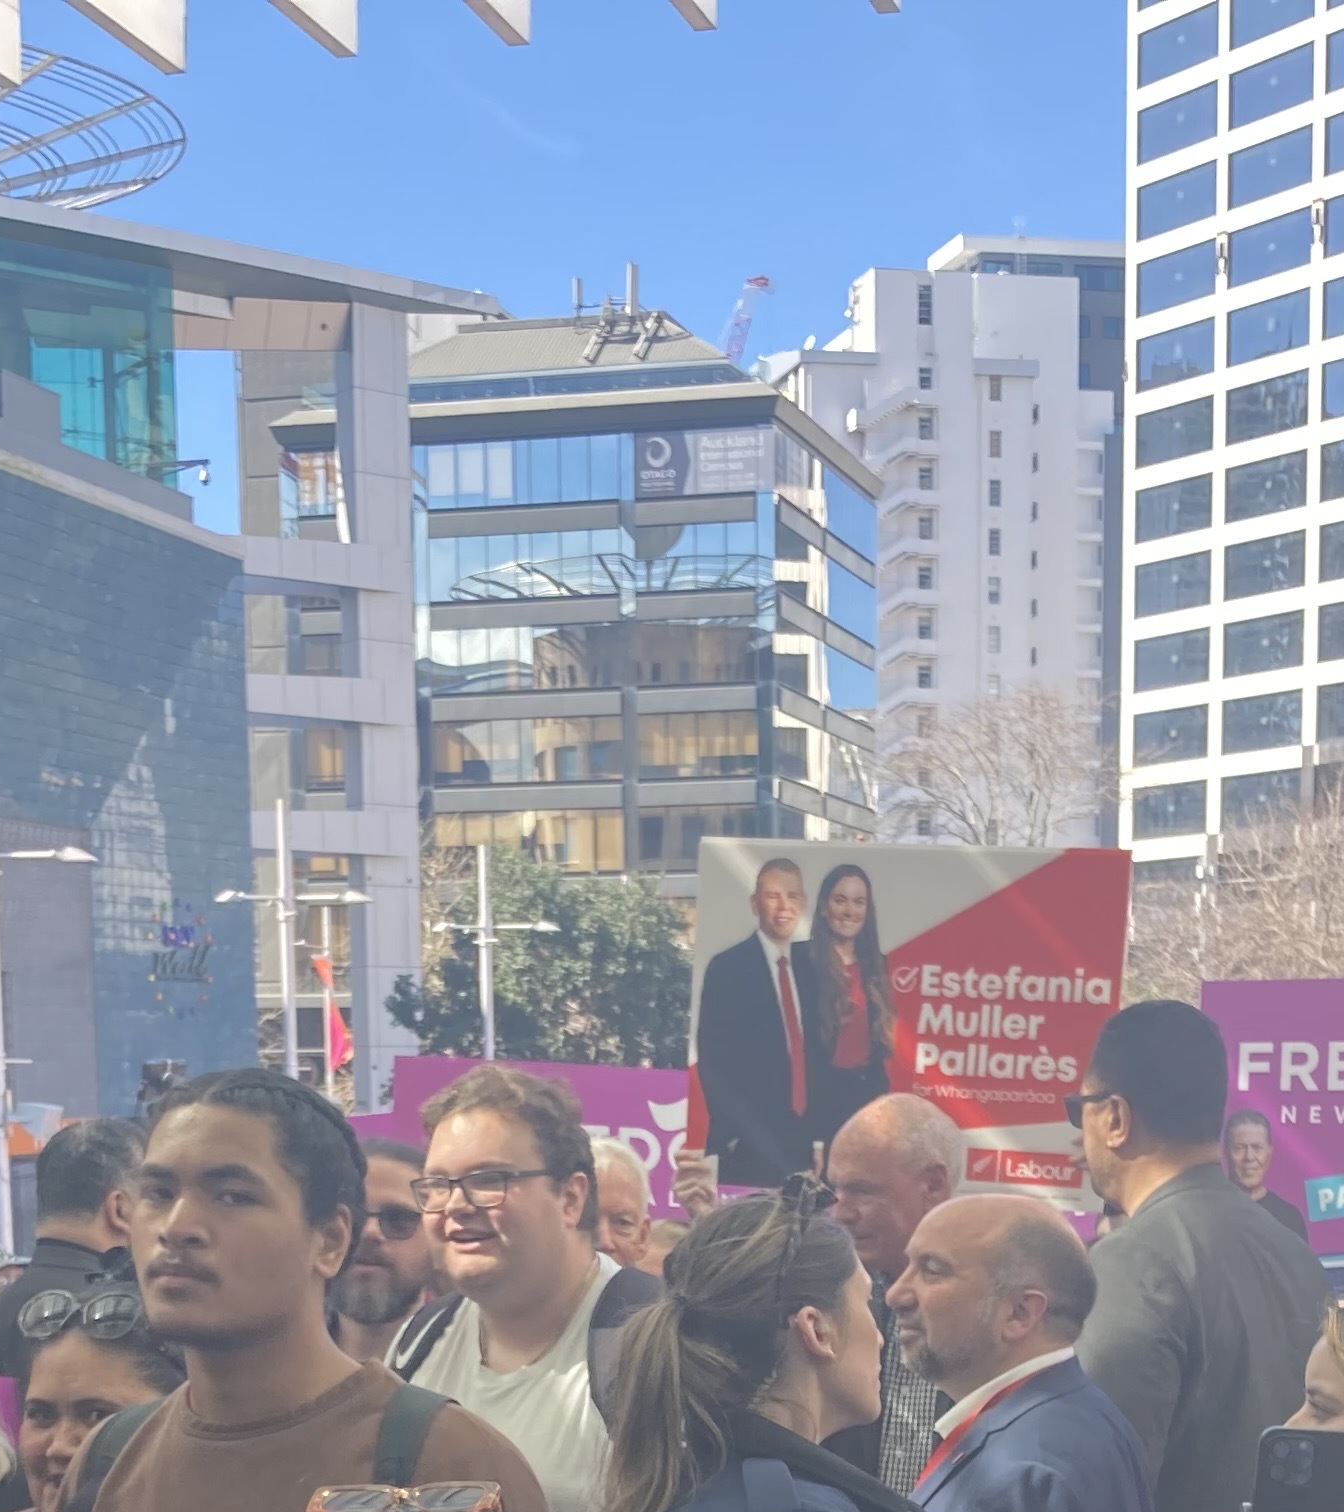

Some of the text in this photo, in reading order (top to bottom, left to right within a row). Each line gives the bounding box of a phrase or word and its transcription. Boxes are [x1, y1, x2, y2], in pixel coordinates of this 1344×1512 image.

[920, 963, 1113, 1005] Estefania
[916, 1002, 1045, 1041] Muller
[914, 1042, 1079, 1083] Pallarès
[912, 1082, 933, 1098] for
[1005, 1157, 1077, 1183] Labour
